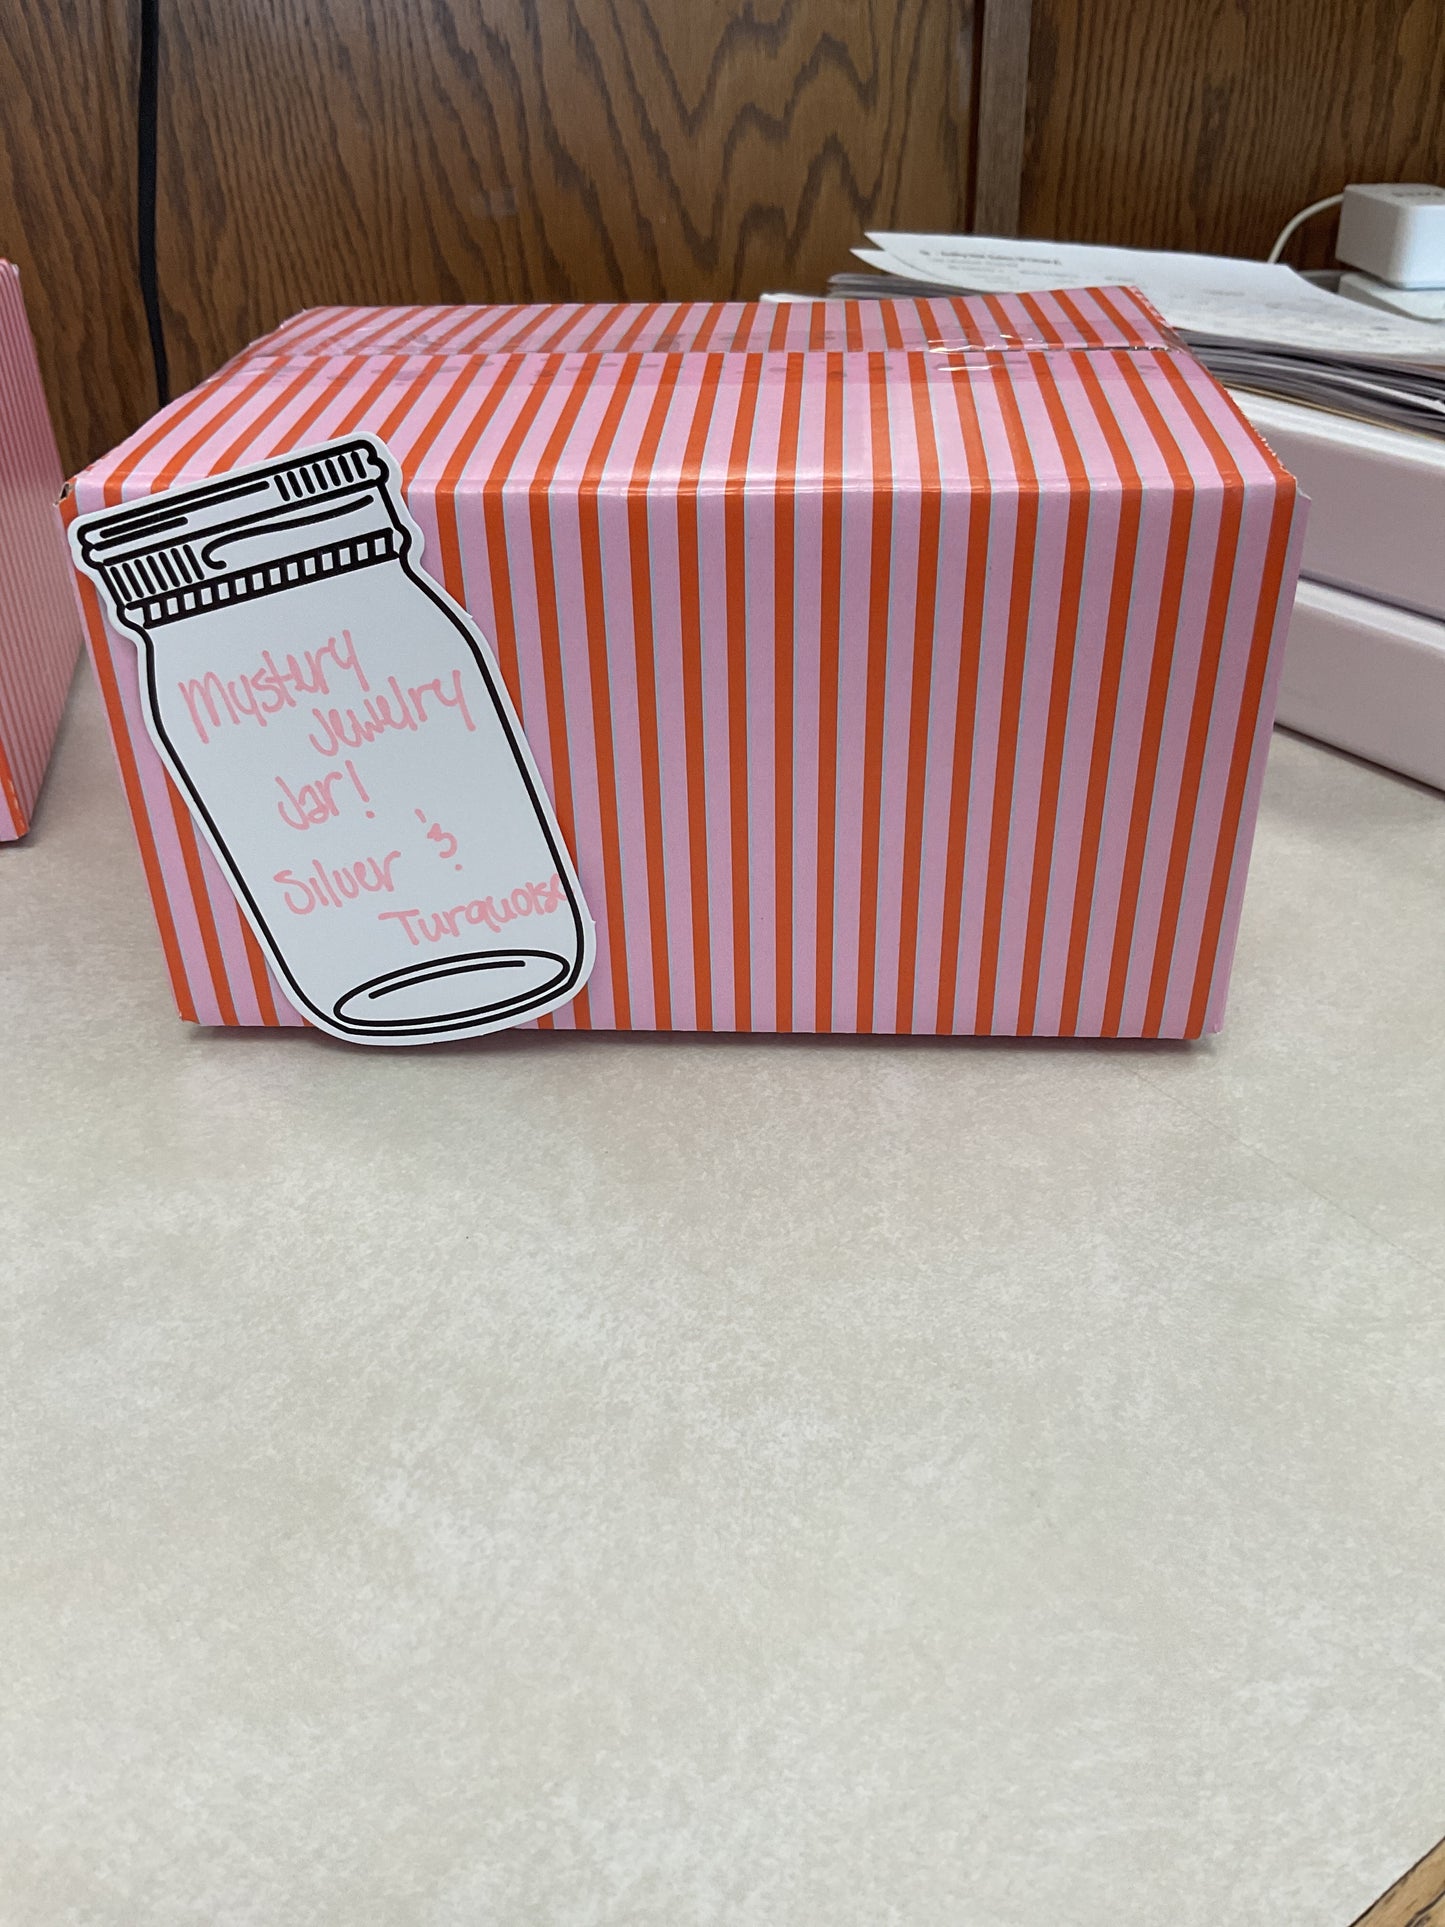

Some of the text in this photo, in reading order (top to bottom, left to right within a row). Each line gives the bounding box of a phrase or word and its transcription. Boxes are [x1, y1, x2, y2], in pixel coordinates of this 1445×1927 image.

[177, 629, 370, 745] Mystery
[309, 669, 476, 757] Jewelry
[275, 760, 376, 831] Jar!
[272, 850, 401, 916] Silver
